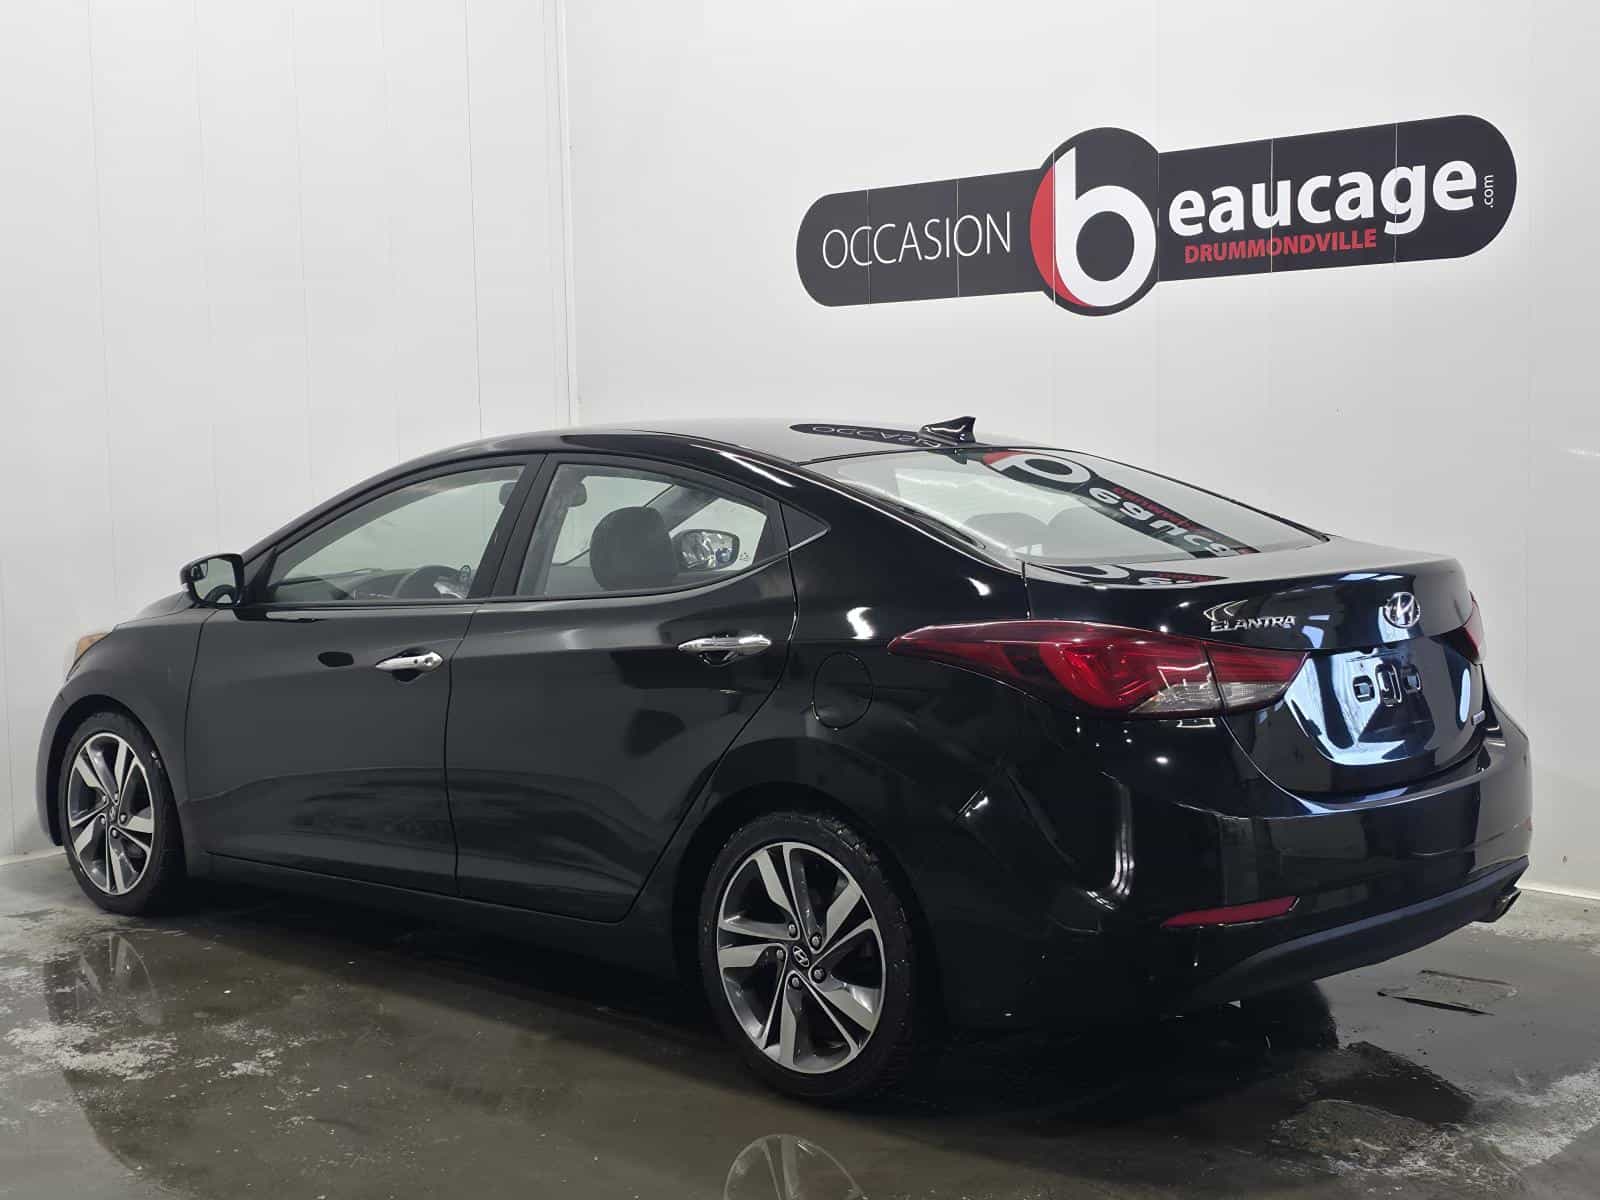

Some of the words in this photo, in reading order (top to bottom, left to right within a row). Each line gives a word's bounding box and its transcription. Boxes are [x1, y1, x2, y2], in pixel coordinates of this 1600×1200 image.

[1483, 174, 1495, 209] .com
[821, 210, 1012, 270] OCCASION
[1184, 228, 1377, 264] DRUMMONDVILLE
[1210, 615, 1296, 632] ELANTRA
